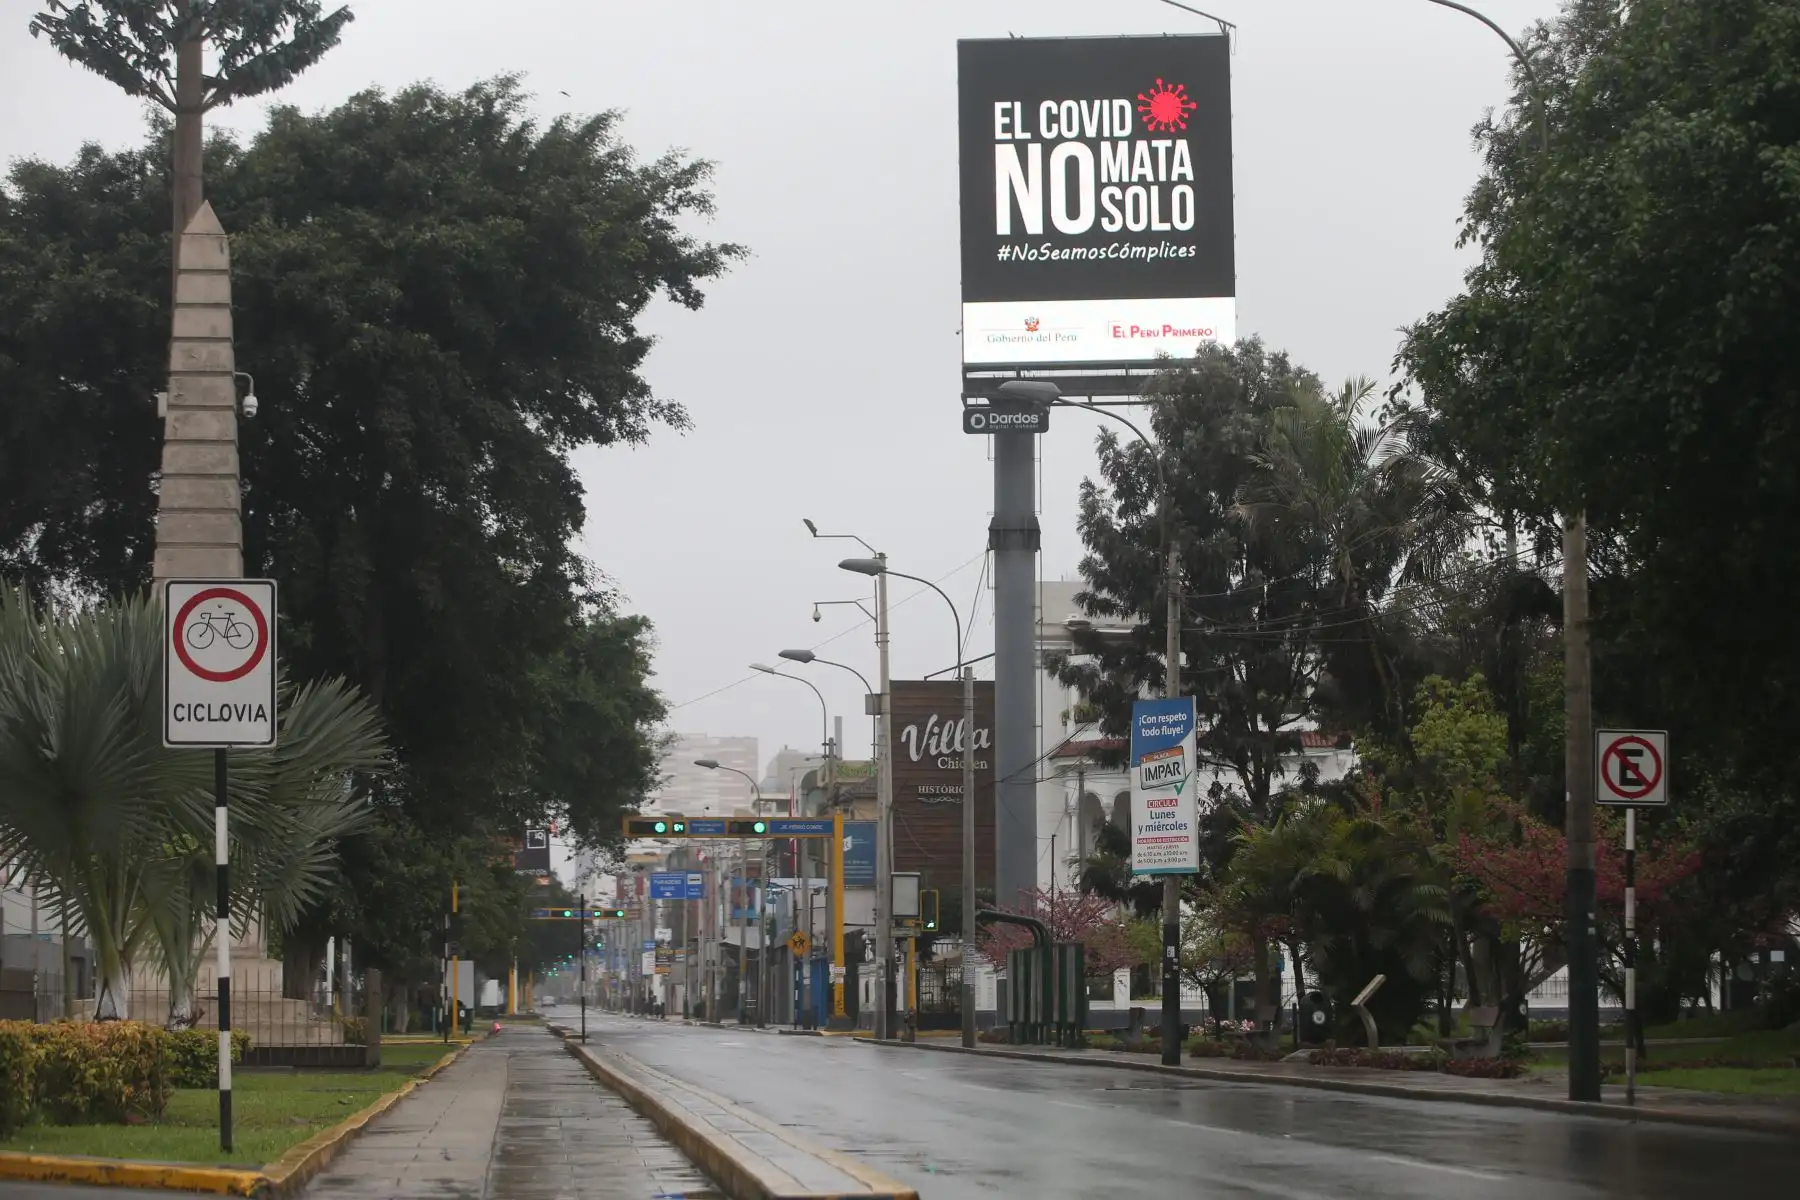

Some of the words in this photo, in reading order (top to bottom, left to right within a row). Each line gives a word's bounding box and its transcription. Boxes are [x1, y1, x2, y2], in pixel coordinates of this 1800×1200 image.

[995, 101, 1031, 140] EL
[1039, 99, 1132, 139] COVID
[1100, 139, 1194, 182] MATA
[995, 141, 1096, 235] NO
[1100, 184, 1195, 232] SOLO
[997, 241, 1196, 262] #NoSeamosCómplices
[987, 334, 1033, 344] Gobierno
[1036, 333, 1051, 343] del
[989, 412, 1039, 424] Dardos
[173, 703, 268, 723] CICLOVIA
[1139, 714, 1157, 726] ¡Con
[1158, 712, 1187, 724] respeto
[1141, 726, 1160, 737] todo
[1161, 724, 1184, 737] fluye!
[1145, 761, 1181, 781] IMPAR
[1148, 799, 1177, 808] CIRCULA
[1150, 810, 1176, 820] Lunes
[1138, 825, 1143, 834] y
[1145, 820, 1188, 832] miércoles
